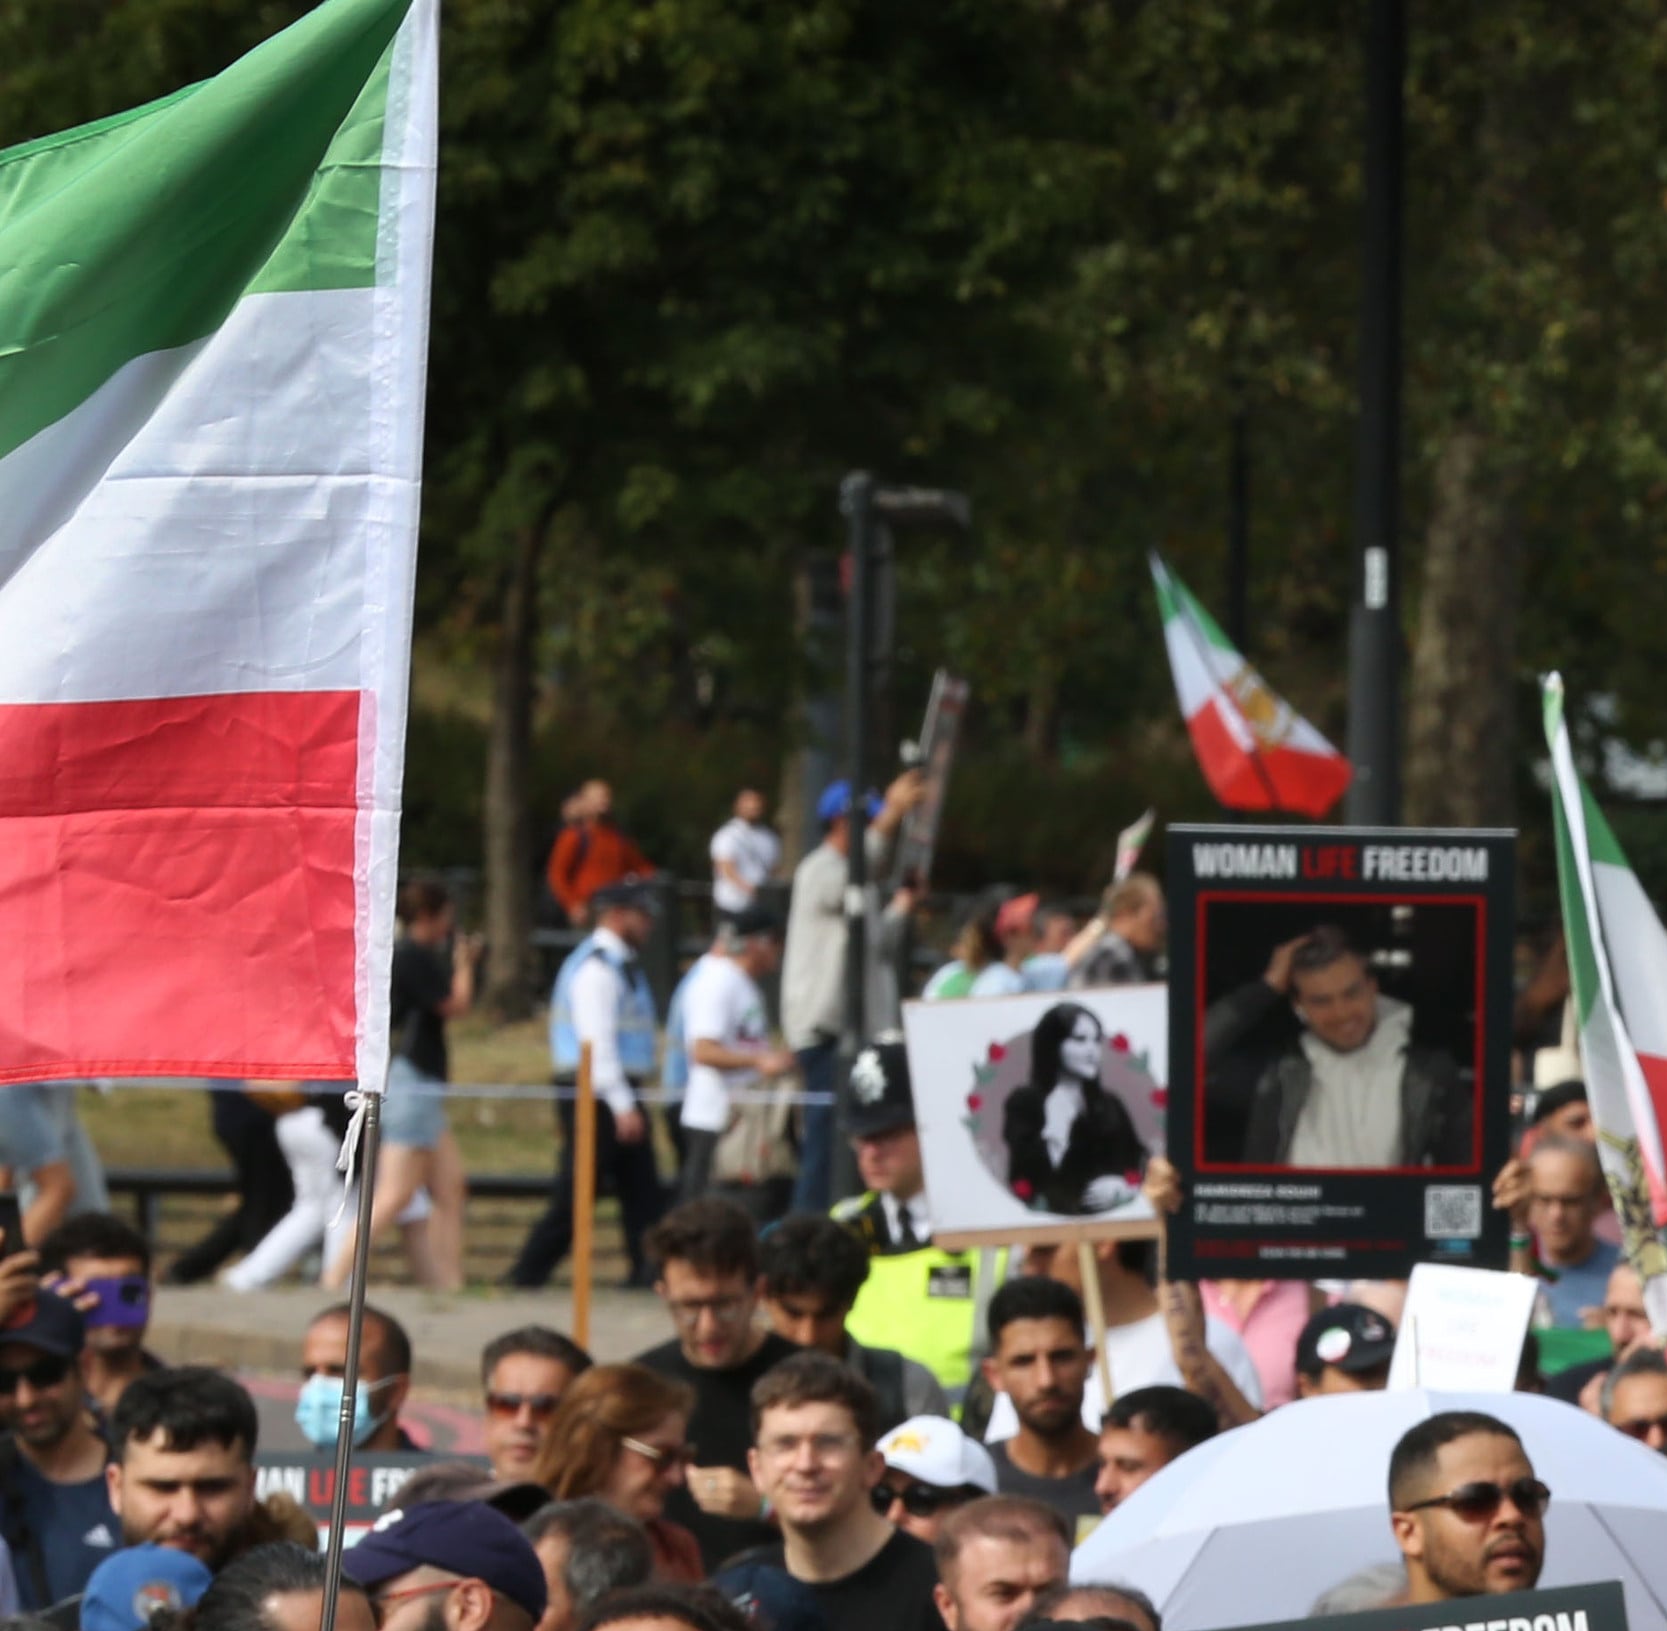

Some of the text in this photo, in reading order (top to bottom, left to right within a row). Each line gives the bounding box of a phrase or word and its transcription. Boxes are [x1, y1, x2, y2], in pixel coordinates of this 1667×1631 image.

[1192, 843, 1489, 882] WOMAN LIFE FREEDOM
